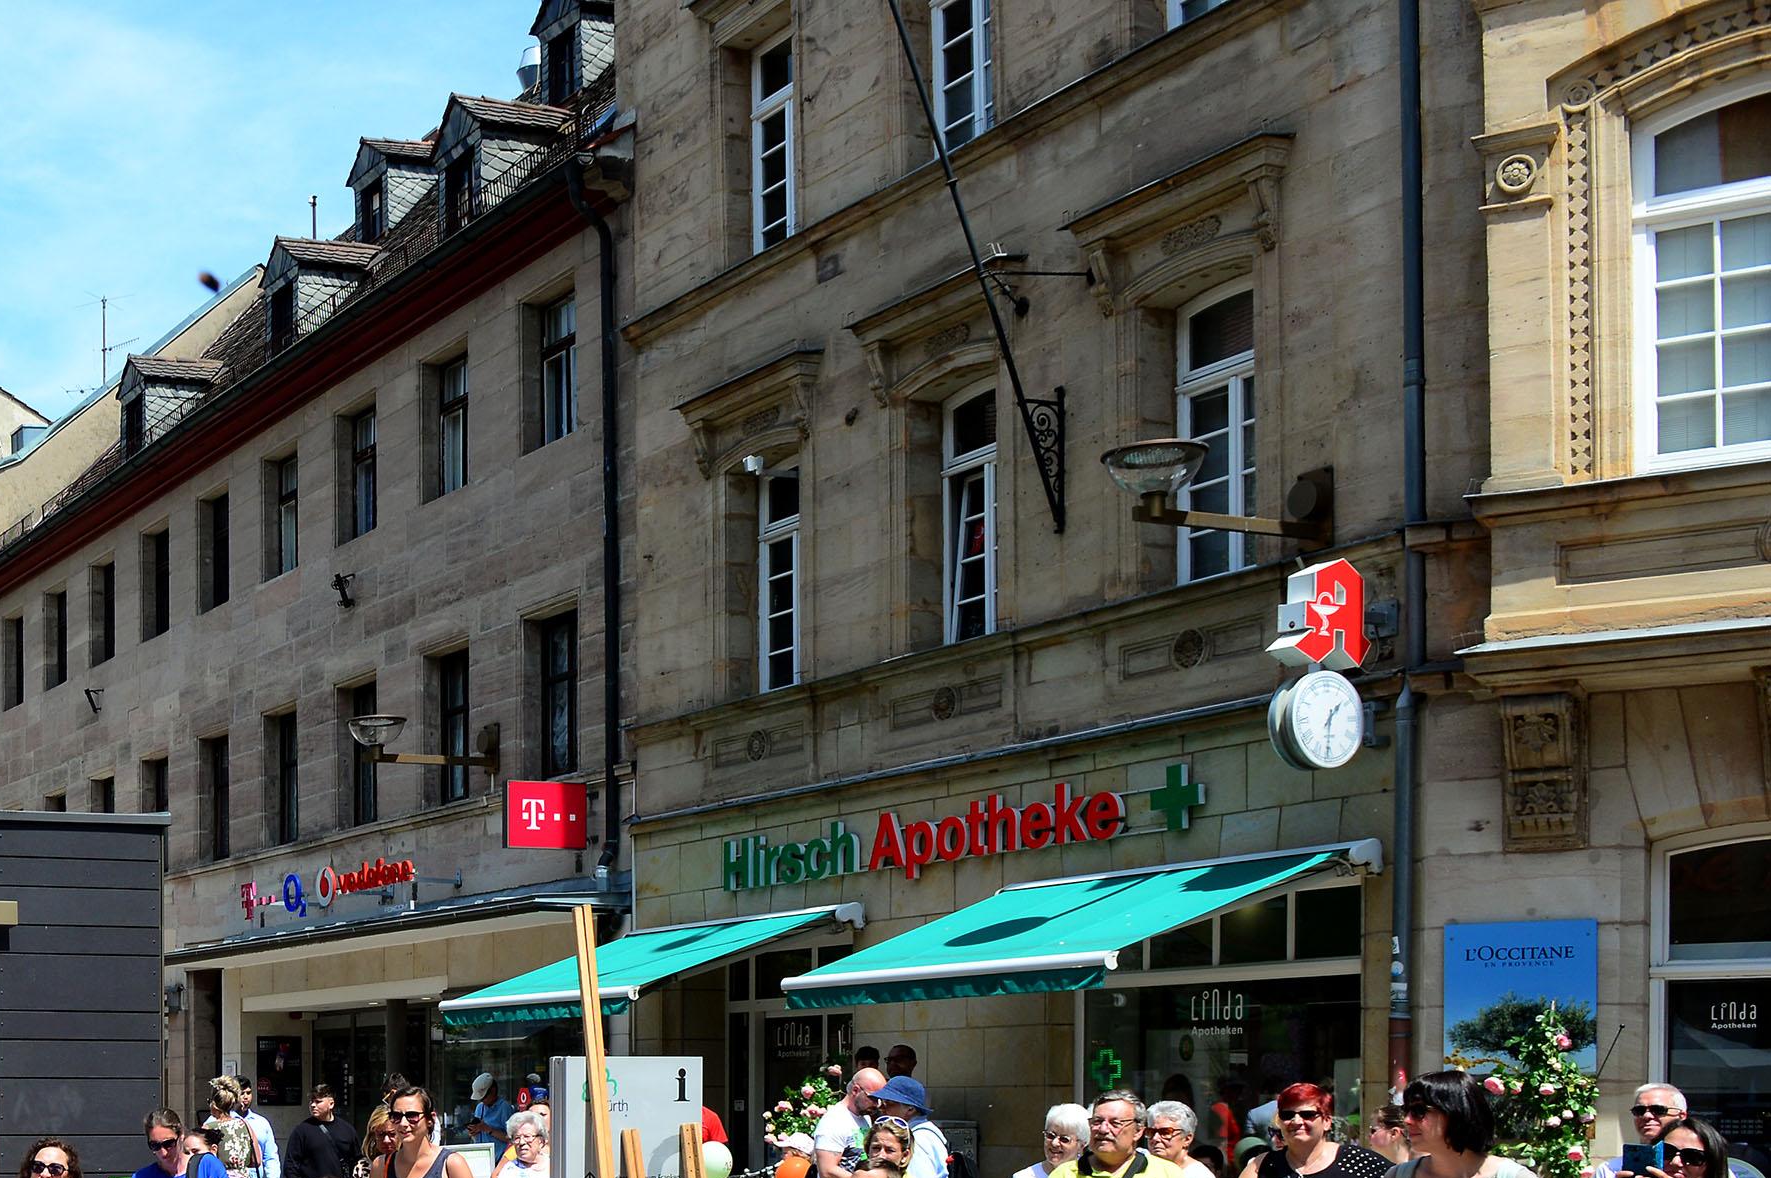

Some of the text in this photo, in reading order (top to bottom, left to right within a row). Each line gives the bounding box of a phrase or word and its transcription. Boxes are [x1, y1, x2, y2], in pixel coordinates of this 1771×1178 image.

[723, 783, 1127, 892] Hirsch Apotheke
[337, 857, 415, 894] vodafone
[1502, 960, 1555, 968] PROVENCE
[1191, 1026, 1243, 1039] Apotheken
[1711, 1022, 1757, 1030] Apotheken
[673, 1067, 691, 1103] i
[608, 1099, 629, 1113] ürth
